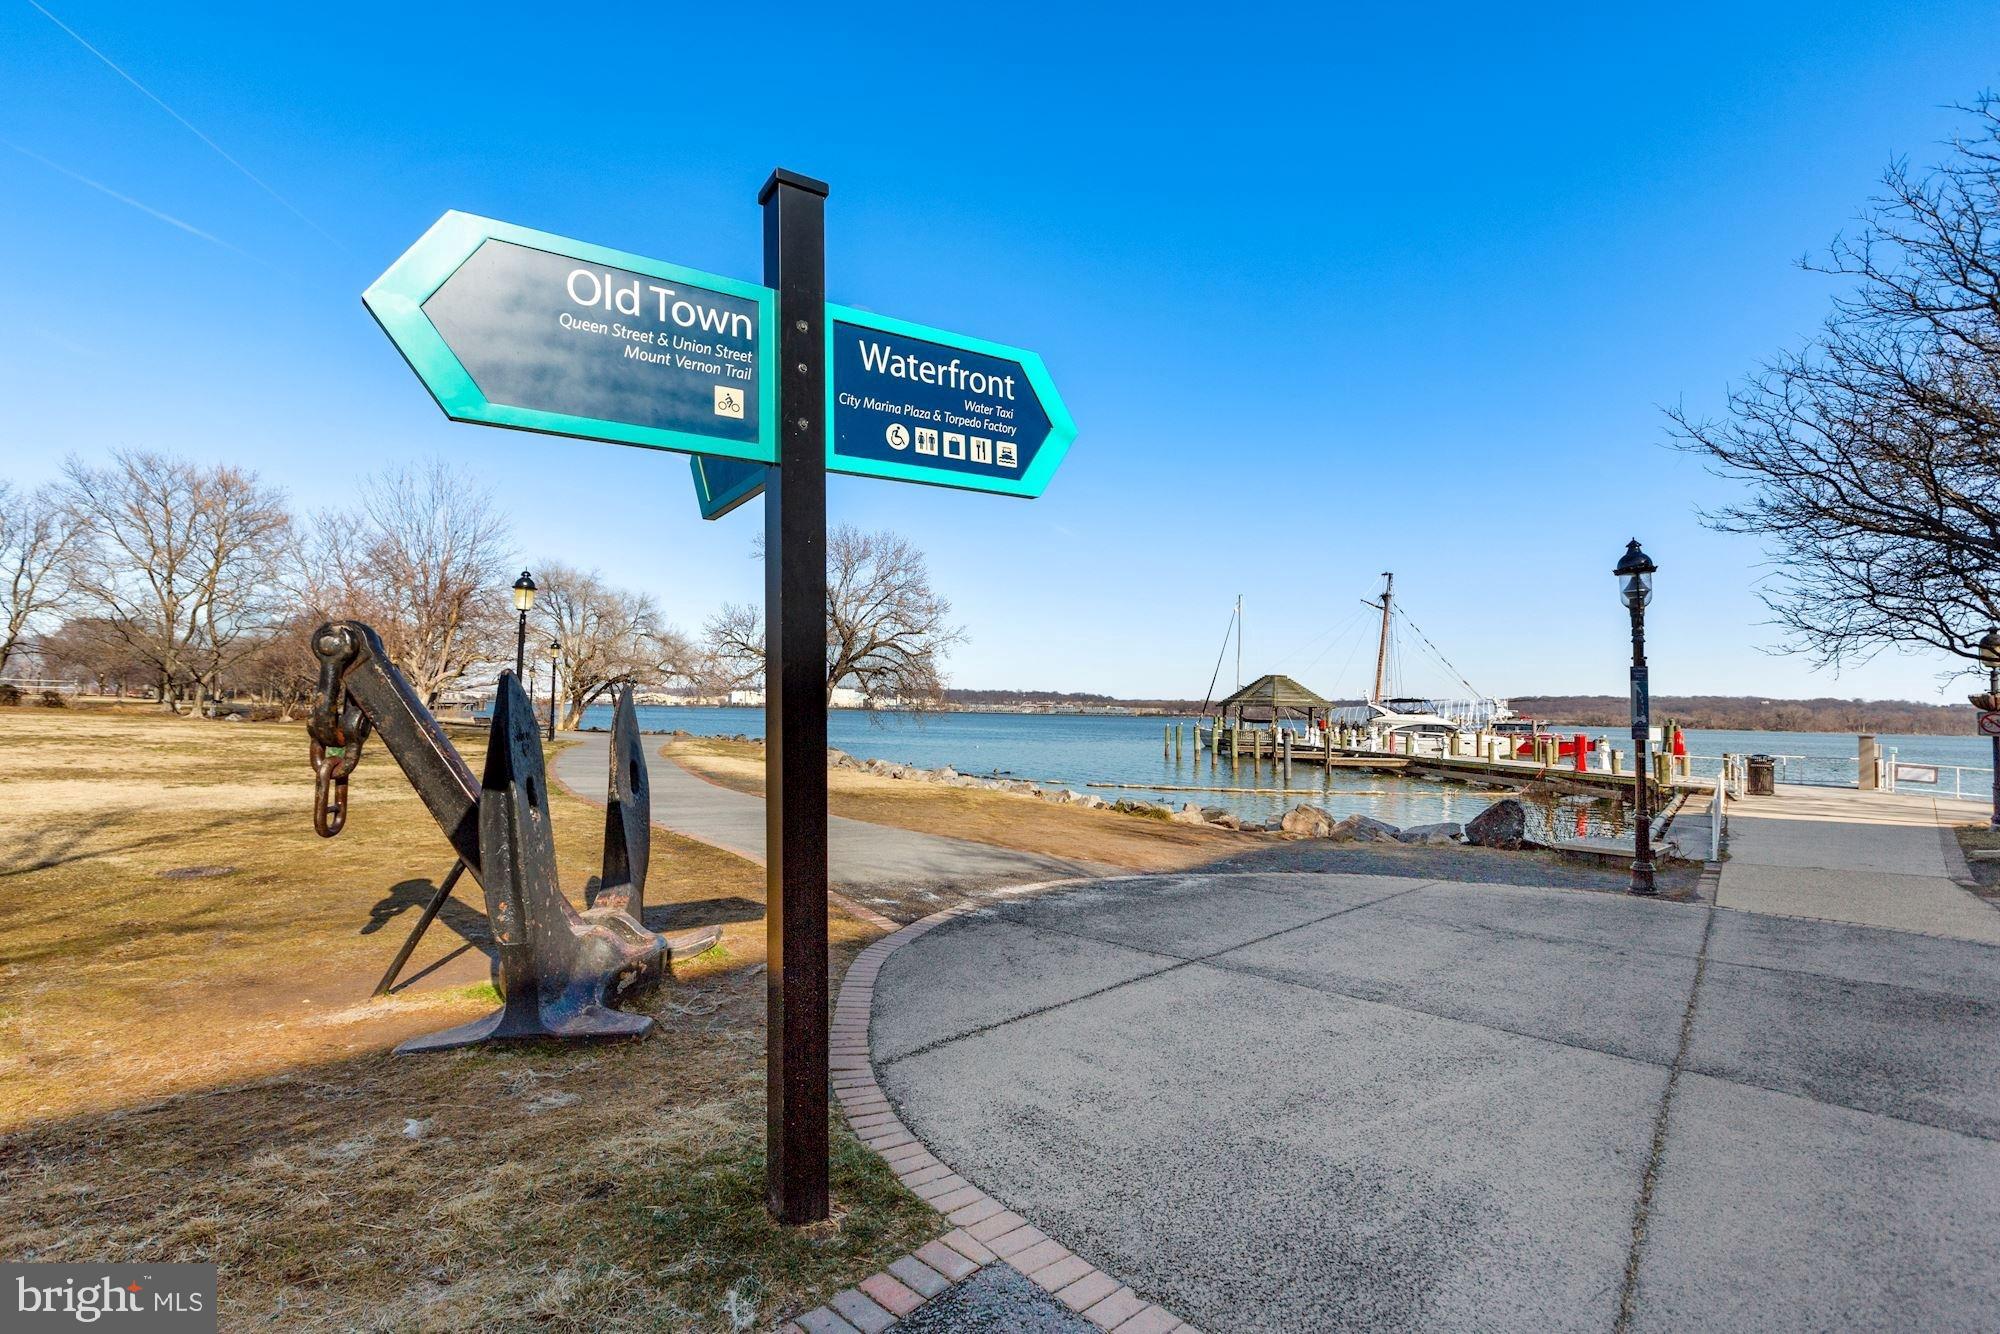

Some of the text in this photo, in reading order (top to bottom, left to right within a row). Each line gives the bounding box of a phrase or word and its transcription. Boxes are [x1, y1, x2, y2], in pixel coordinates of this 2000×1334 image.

[567, 269, 752, 340] Old Town
[559, 313, 752, 363] Queen Street & Union Street
[624, 345, 751, 380] Mount Vernon Trail
[859, 339, 1015, 400] Waterfront
[839, 392, 1017, 437] City Marina Plaza & Torpedo Factory
[964, 400, 1014, 419] Water Taxi
